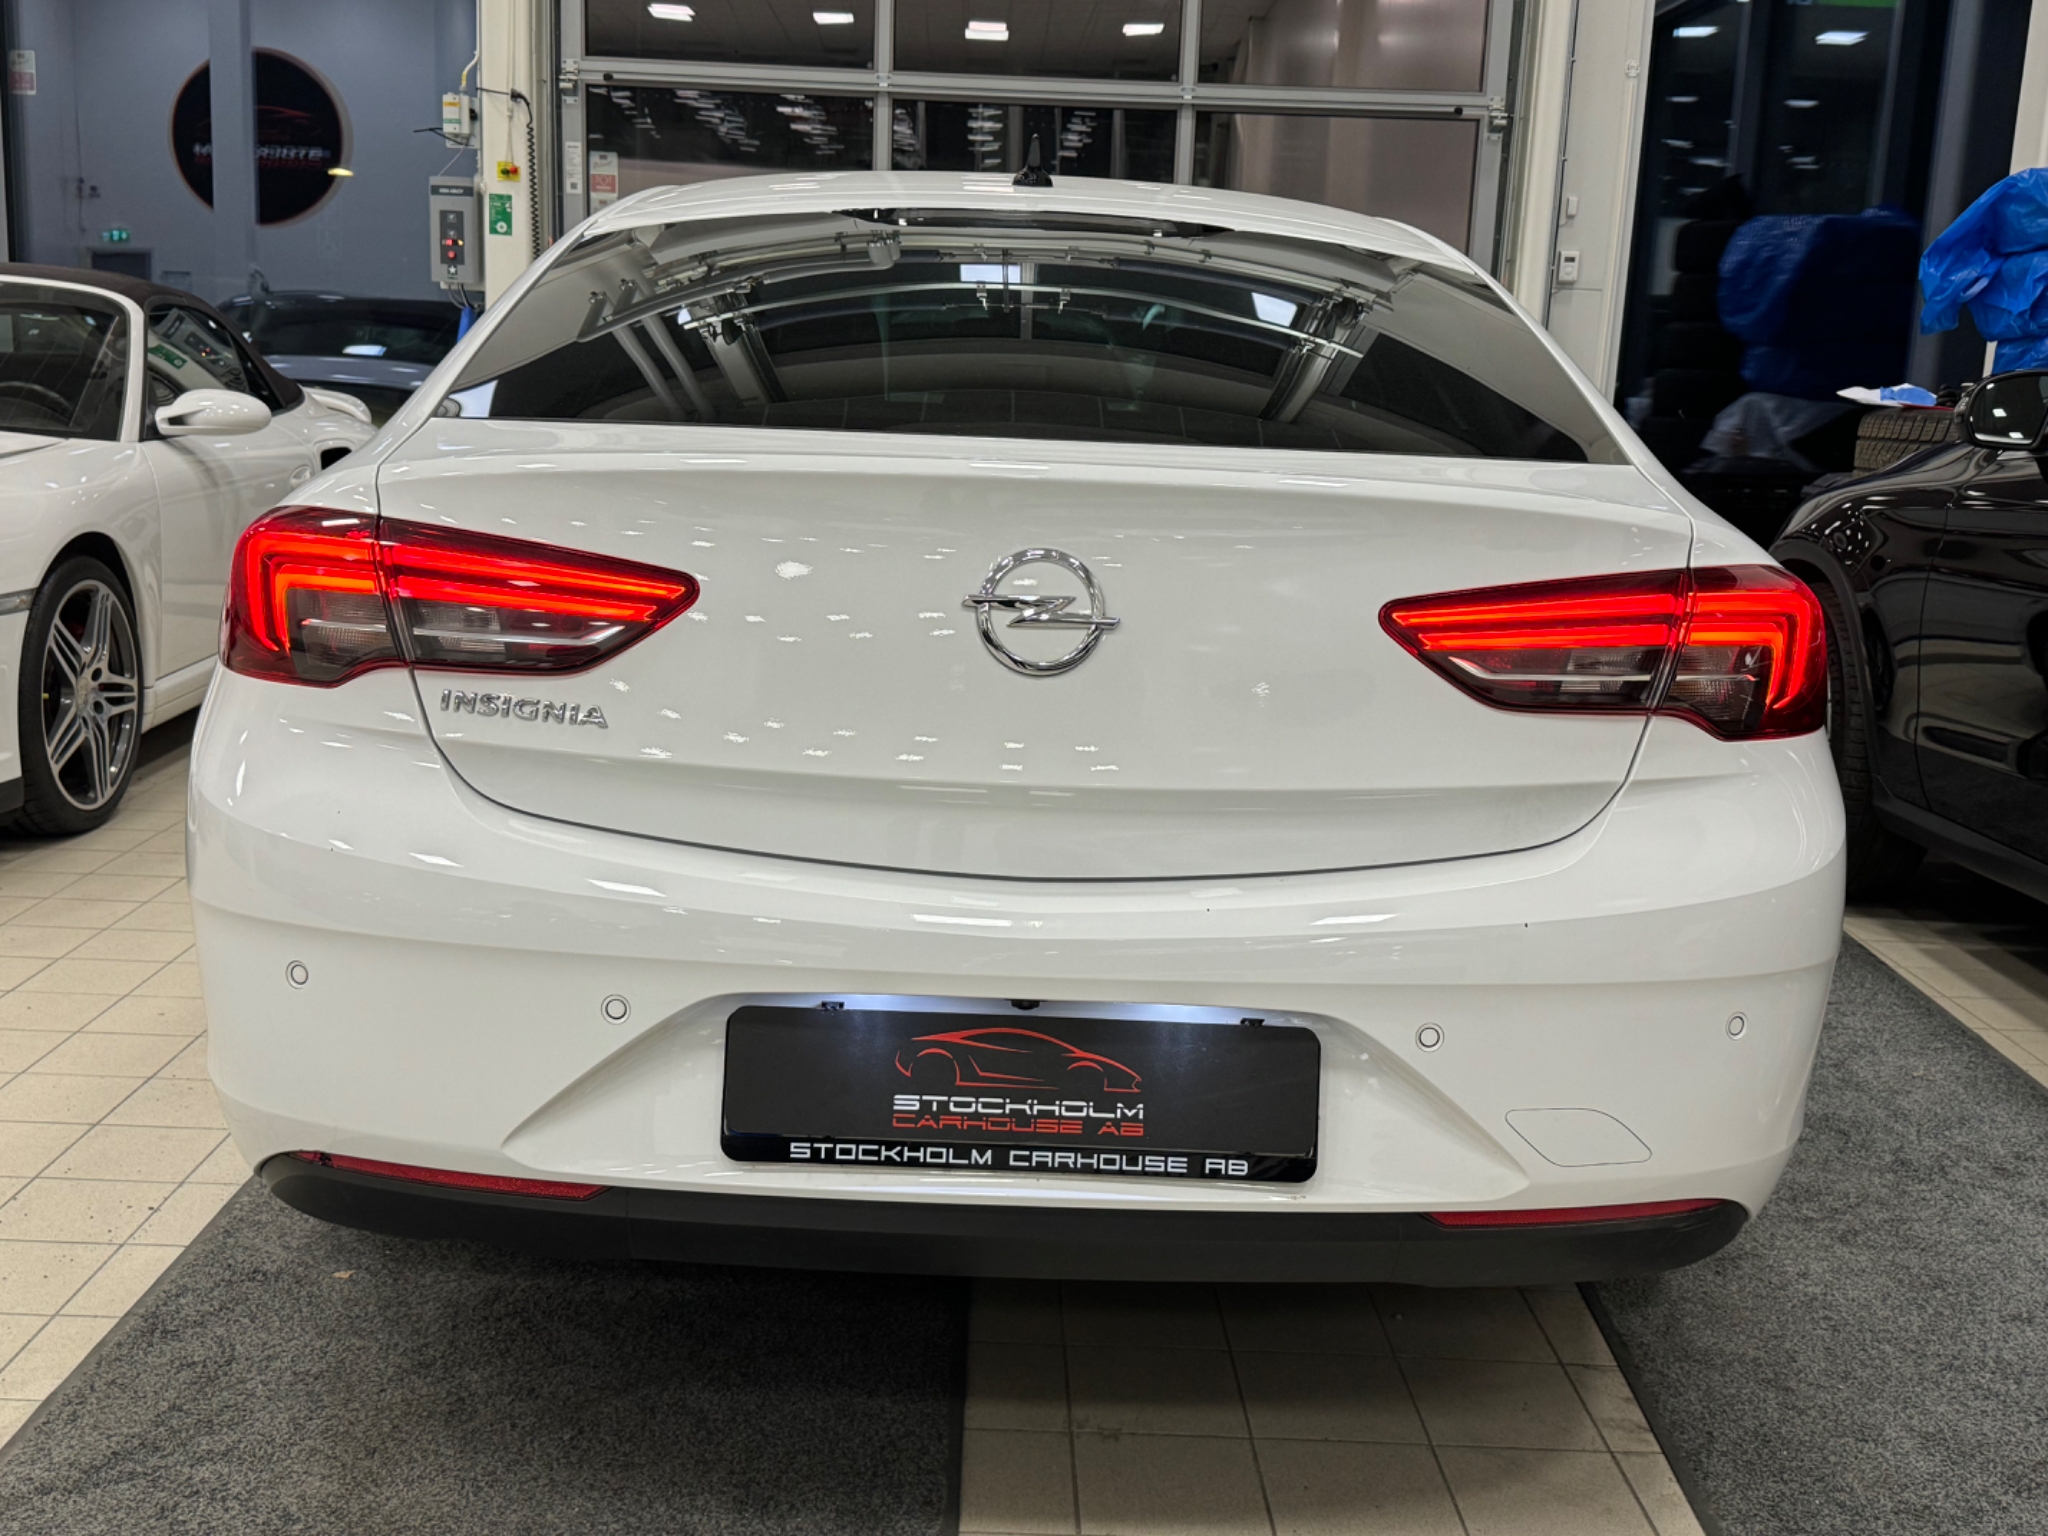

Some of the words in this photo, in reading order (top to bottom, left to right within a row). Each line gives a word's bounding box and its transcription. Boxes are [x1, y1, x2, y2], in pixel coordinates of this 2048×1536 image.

[440, 689, 608, 728] INSIGNIA
[893, 1095, 1143, 1119] STOCKHOLM
[893, 1113, 1083, 1134] CARHOUSE
[1098, 1121, 1144, 1136] AB
[790, 1142, 992, 1165] STOCKHOLM
[1009, 1150, 1188, 1173] CARHOUSE
[1205, 1158, 1249, 1175] AB
